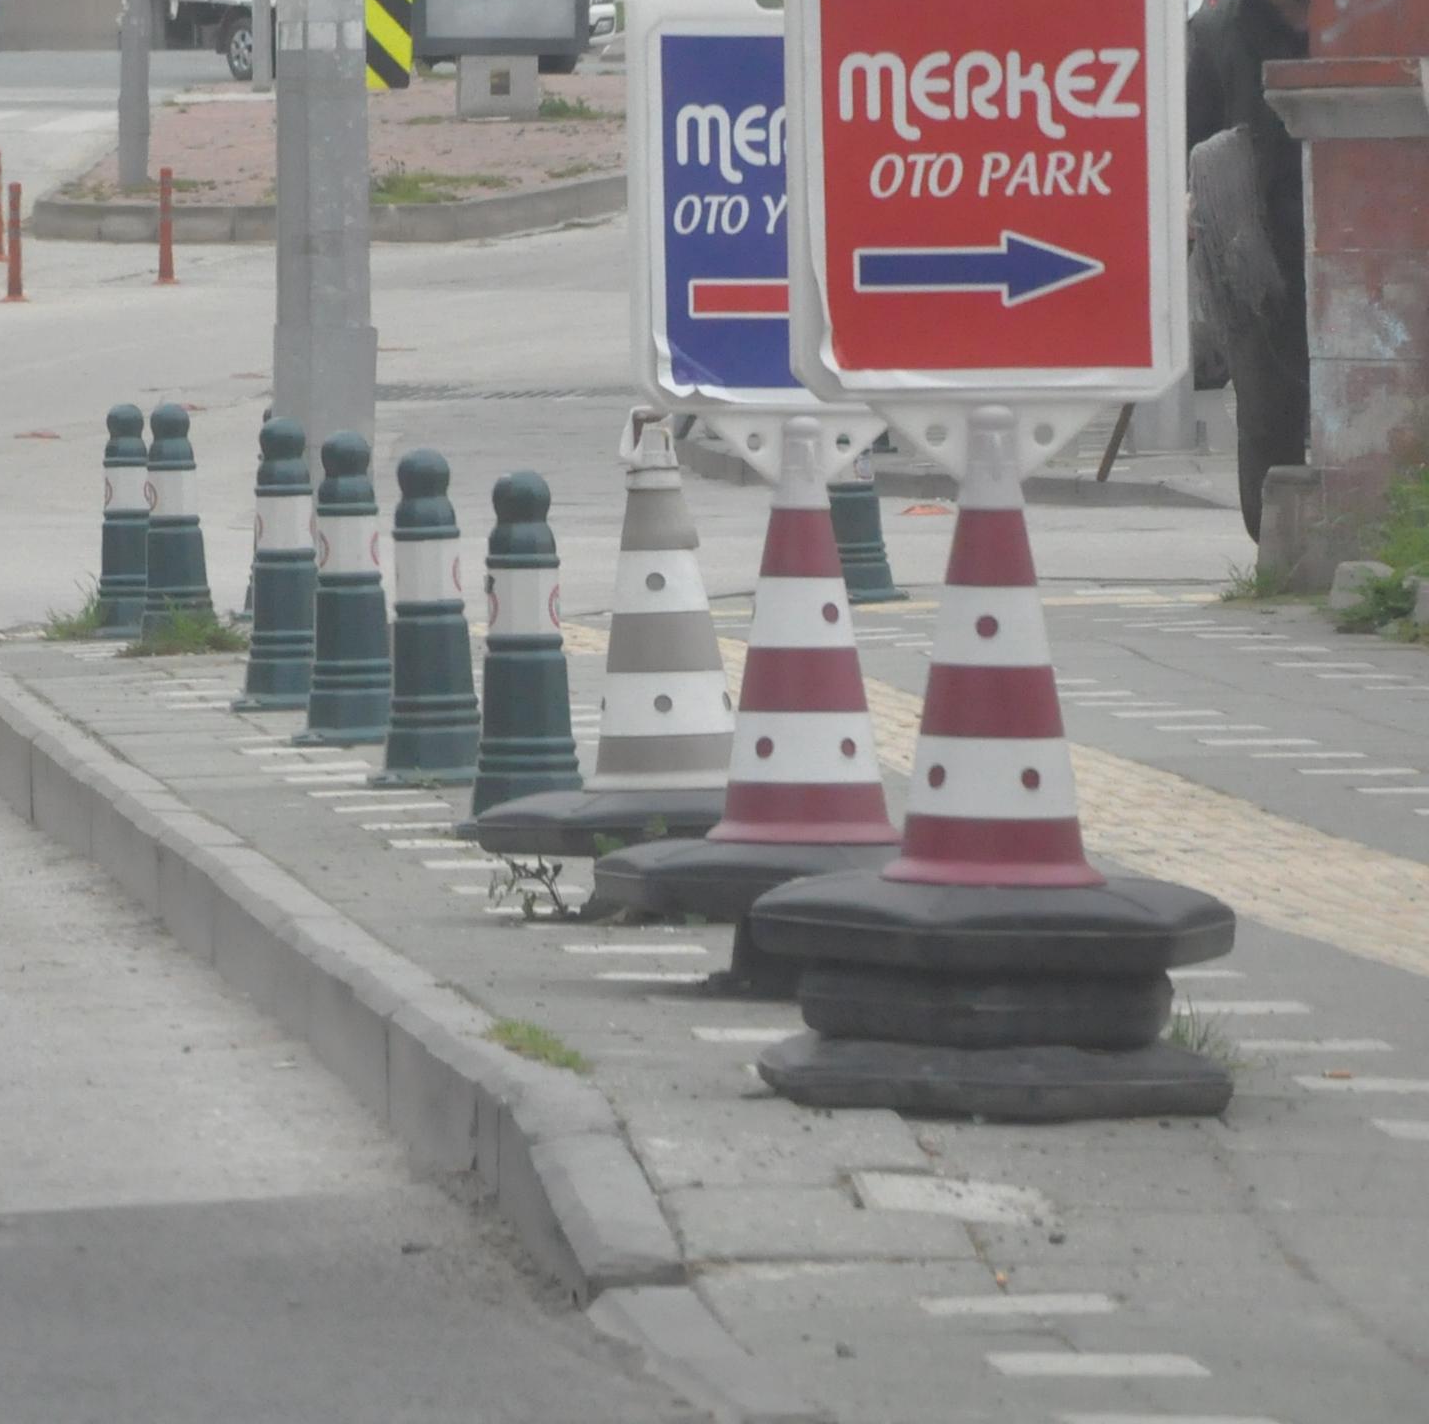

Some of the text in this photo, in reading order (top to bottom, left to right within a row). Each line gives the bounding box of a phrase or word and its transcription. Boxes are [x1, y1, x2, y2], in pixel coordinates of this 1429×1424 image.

[838, 48, 1141, 141] MERKEZ
[869, 150, 1113, 199] OTO PARK
[673, 194, 788, 235] OTO Y
